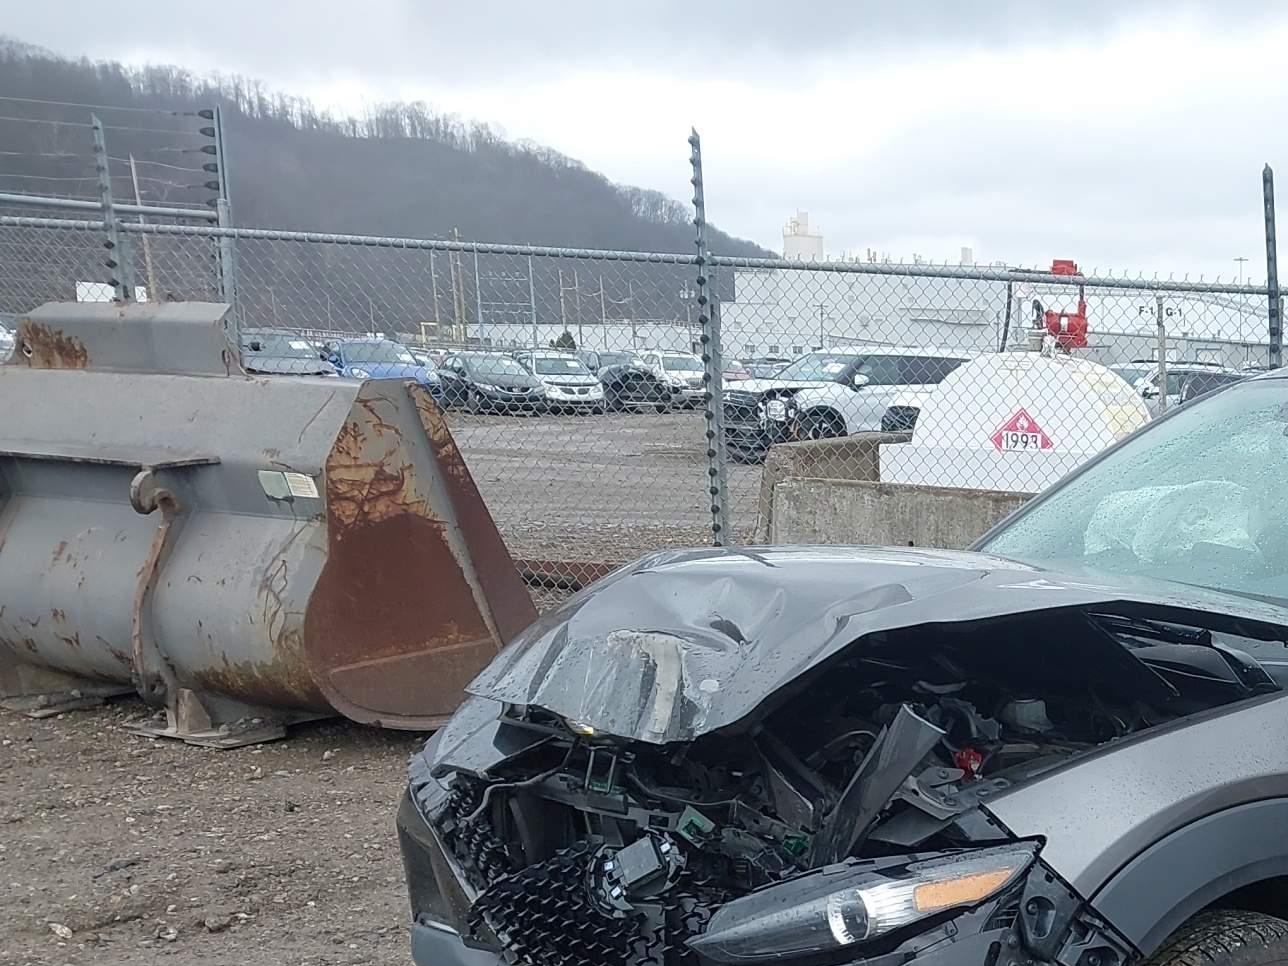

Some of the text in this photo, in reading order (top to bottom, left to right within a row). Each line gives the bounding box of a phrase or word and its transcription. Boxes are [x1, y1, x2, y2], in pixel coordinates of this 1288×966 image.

[1139, 306, 1154, 316] F-1
[1165, 307, 1182, 317] G-1
[1005, 432, 1038, 449] 1993
